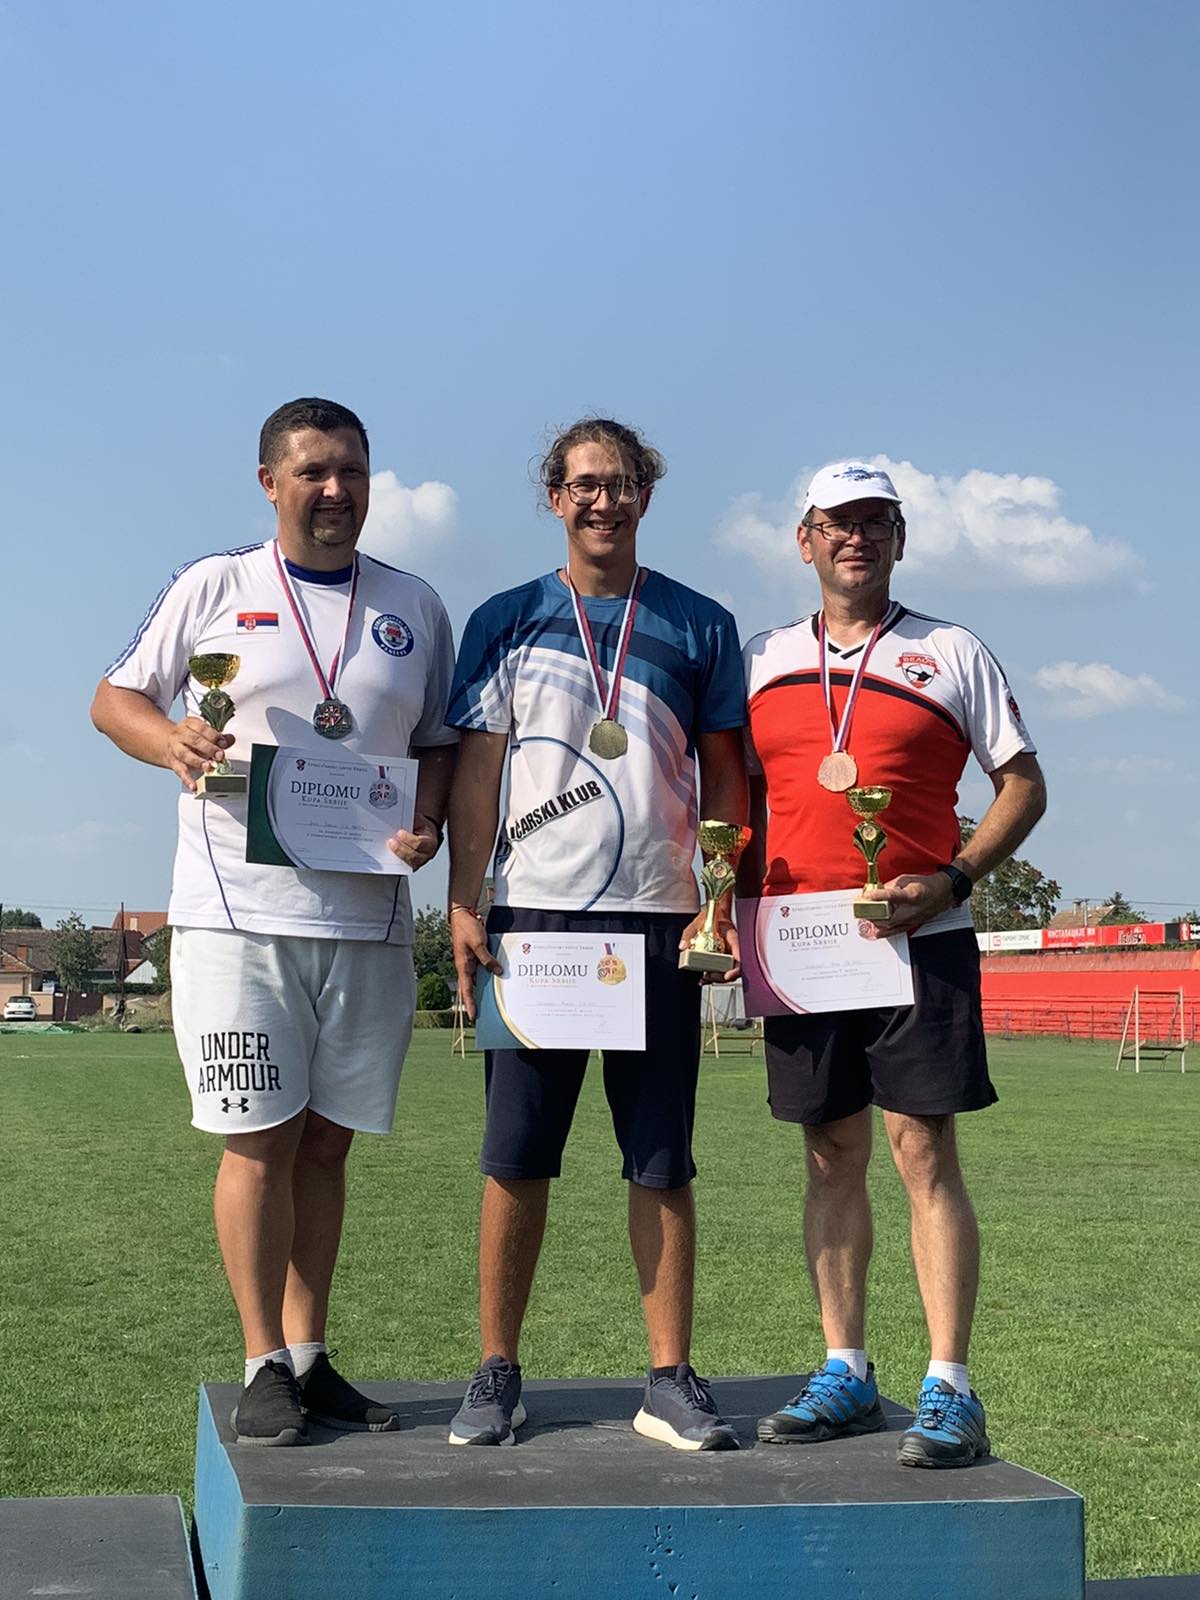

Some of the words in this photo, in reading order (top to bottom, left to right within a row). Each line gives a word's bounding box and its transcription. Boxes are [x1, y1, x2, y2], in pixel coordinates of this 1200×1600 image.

[291, 781, 360, 799] DIPLOMU
[556, 780, 602, 811] KLUB
[779, 923, 849, 941] DIPLOMU
[518, 964, 588, 977] DIPLOMU
[201, 1032, 270, 1061] UNDER
[198, 1063, 282, 1094] ARMOUR
